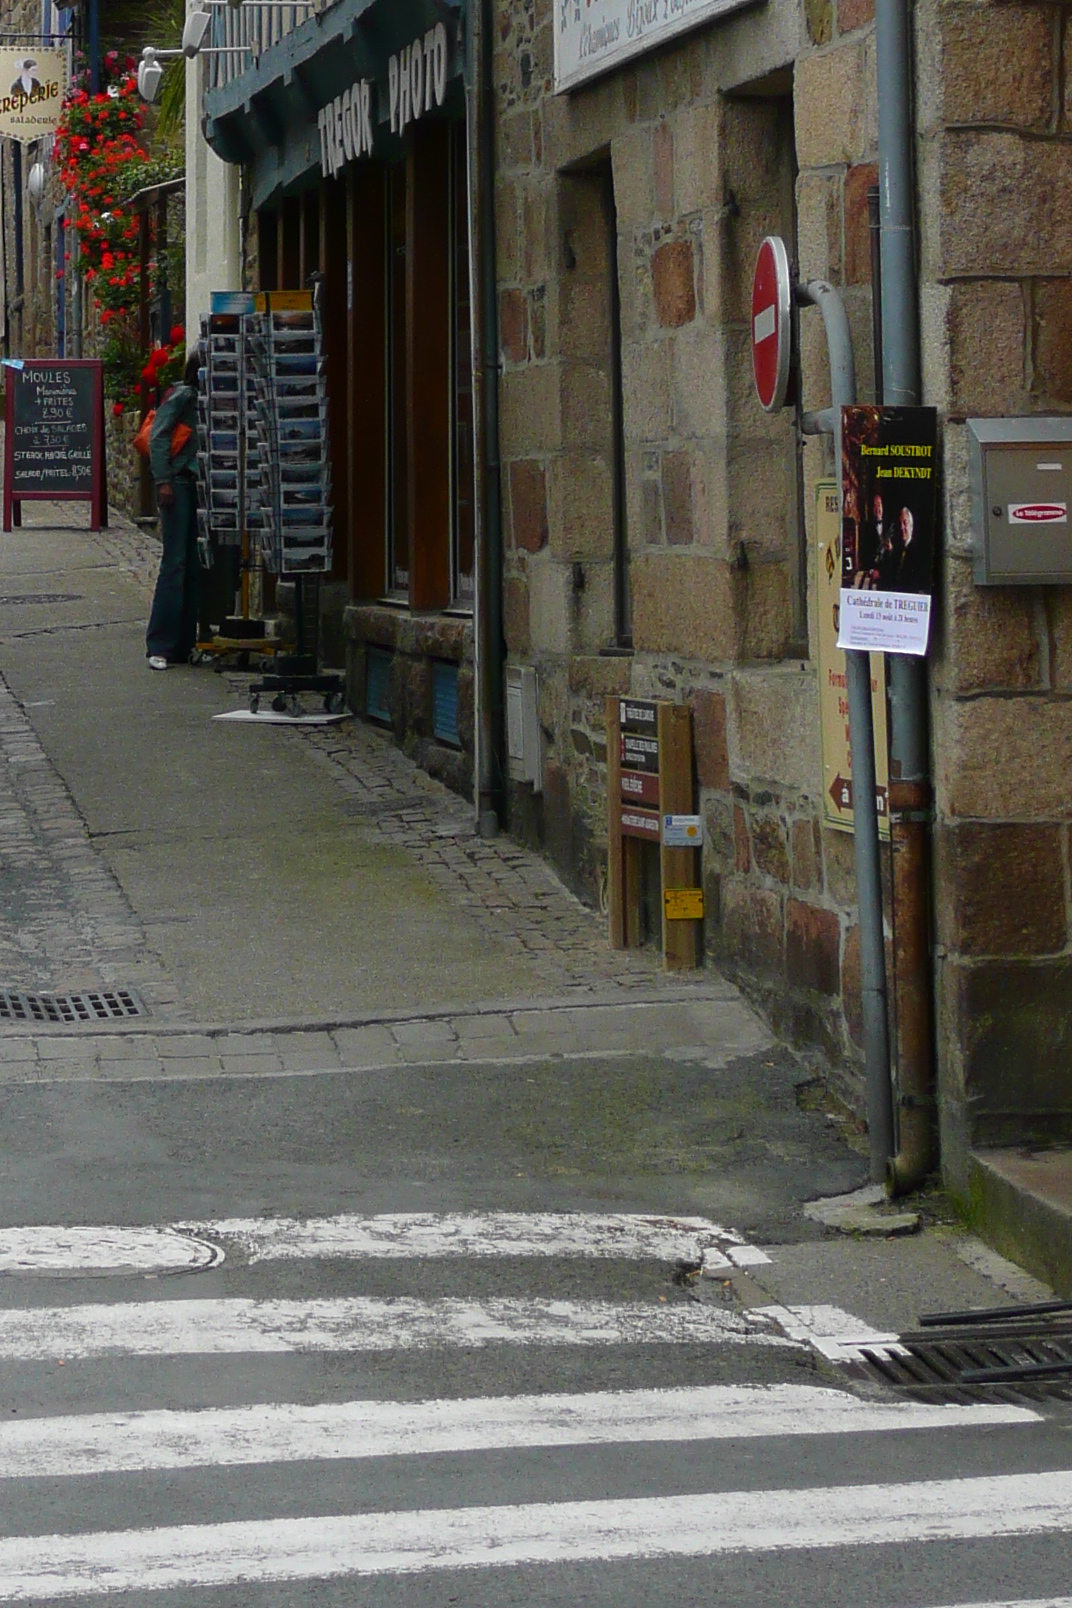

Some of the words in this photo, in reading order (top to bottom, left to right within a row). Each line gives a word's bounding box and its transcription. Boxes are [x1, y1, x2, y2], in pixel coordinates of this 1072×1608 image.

[388, 21, 447, 138] PHOTO
[22, 370, 71, 384] MOULES
[861, 444, 889, 456] Bernard
[890, 444, 932, 457] SOUSTROT
[876, 466, 893, 479] Jean
[847, 595, 884, 609] Cathédrale
